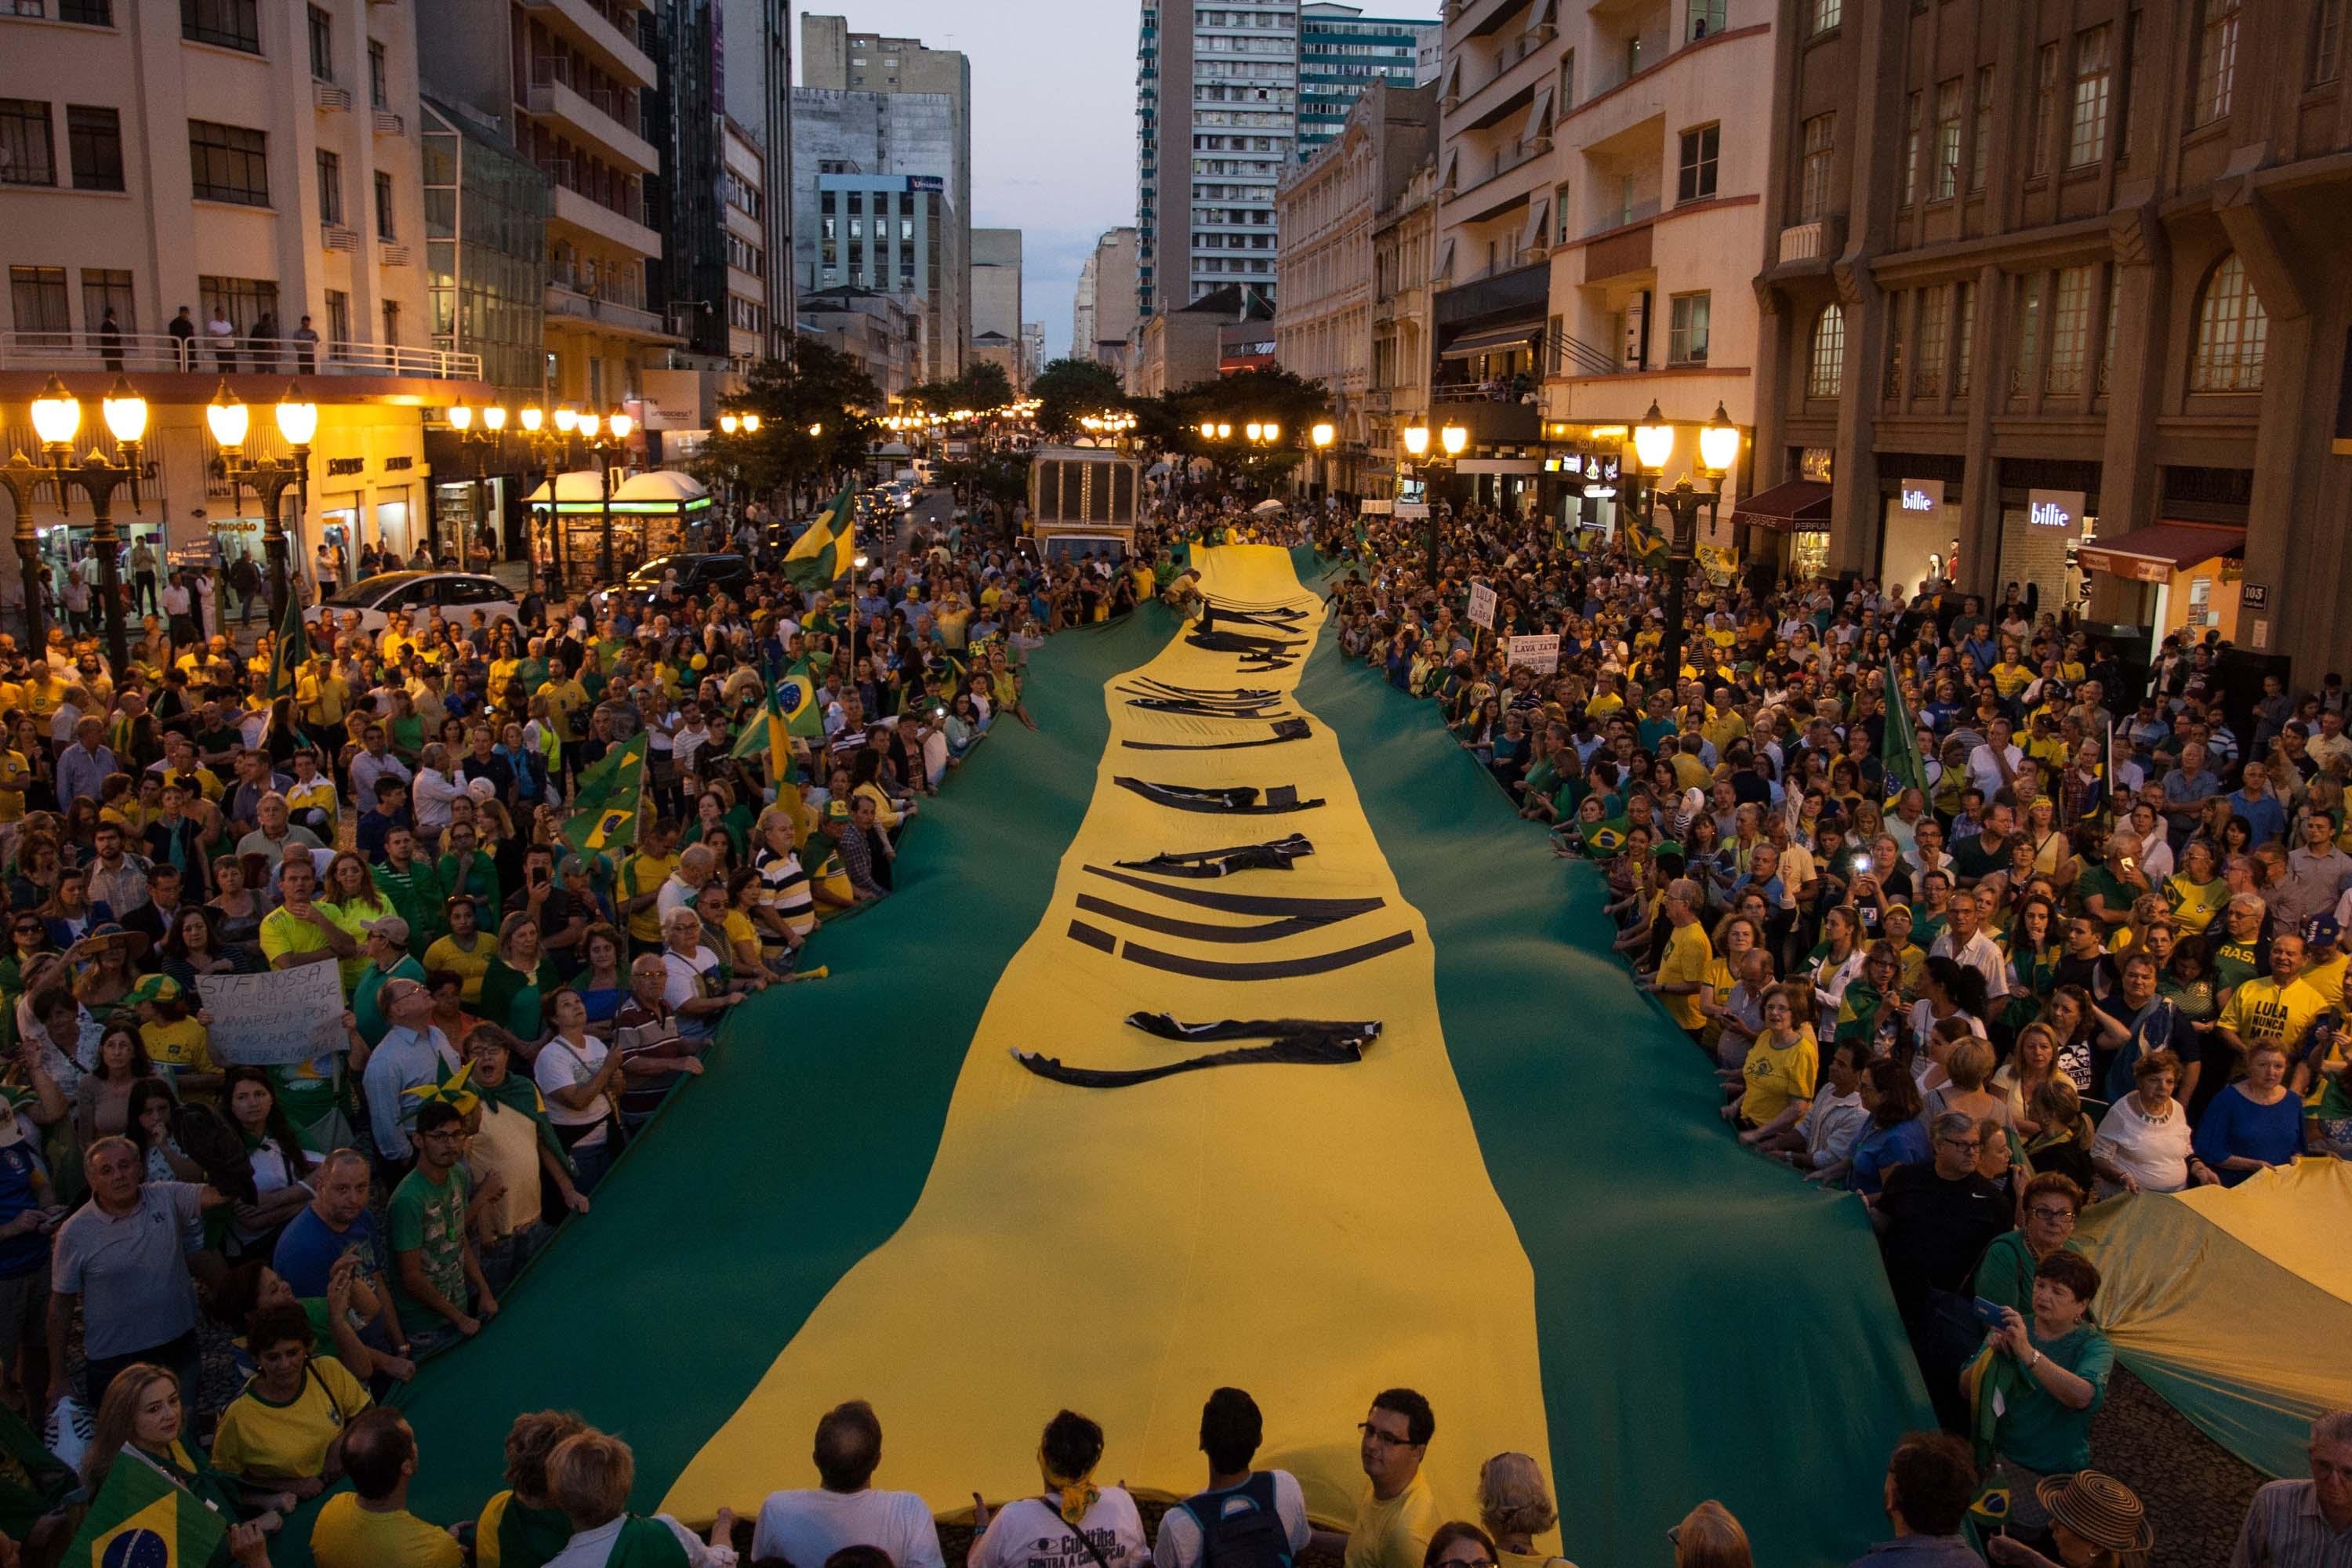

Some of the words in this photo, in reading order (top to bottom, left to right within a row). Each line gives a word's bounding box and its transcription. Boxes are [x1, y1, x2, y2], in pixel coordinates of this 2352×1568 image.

[1902, 490, 1932, 510] billie
[2031, 502, 2069, 526] billie
[1476, 587, 1493, 604] LULA
[1515, 644, 1535, 653] LAVA
[201, 975, 254, 994] STF
[261, 964, 321, 991] NOSSA
[2254, 1000, 2288, 1020] LULA
[2252, 1014, 2285, 1030] NUNCA
[1062, 1527, 1116, 1555] Curitiba
[1078, 1544, 1126, 1566] COUPÇÃO
